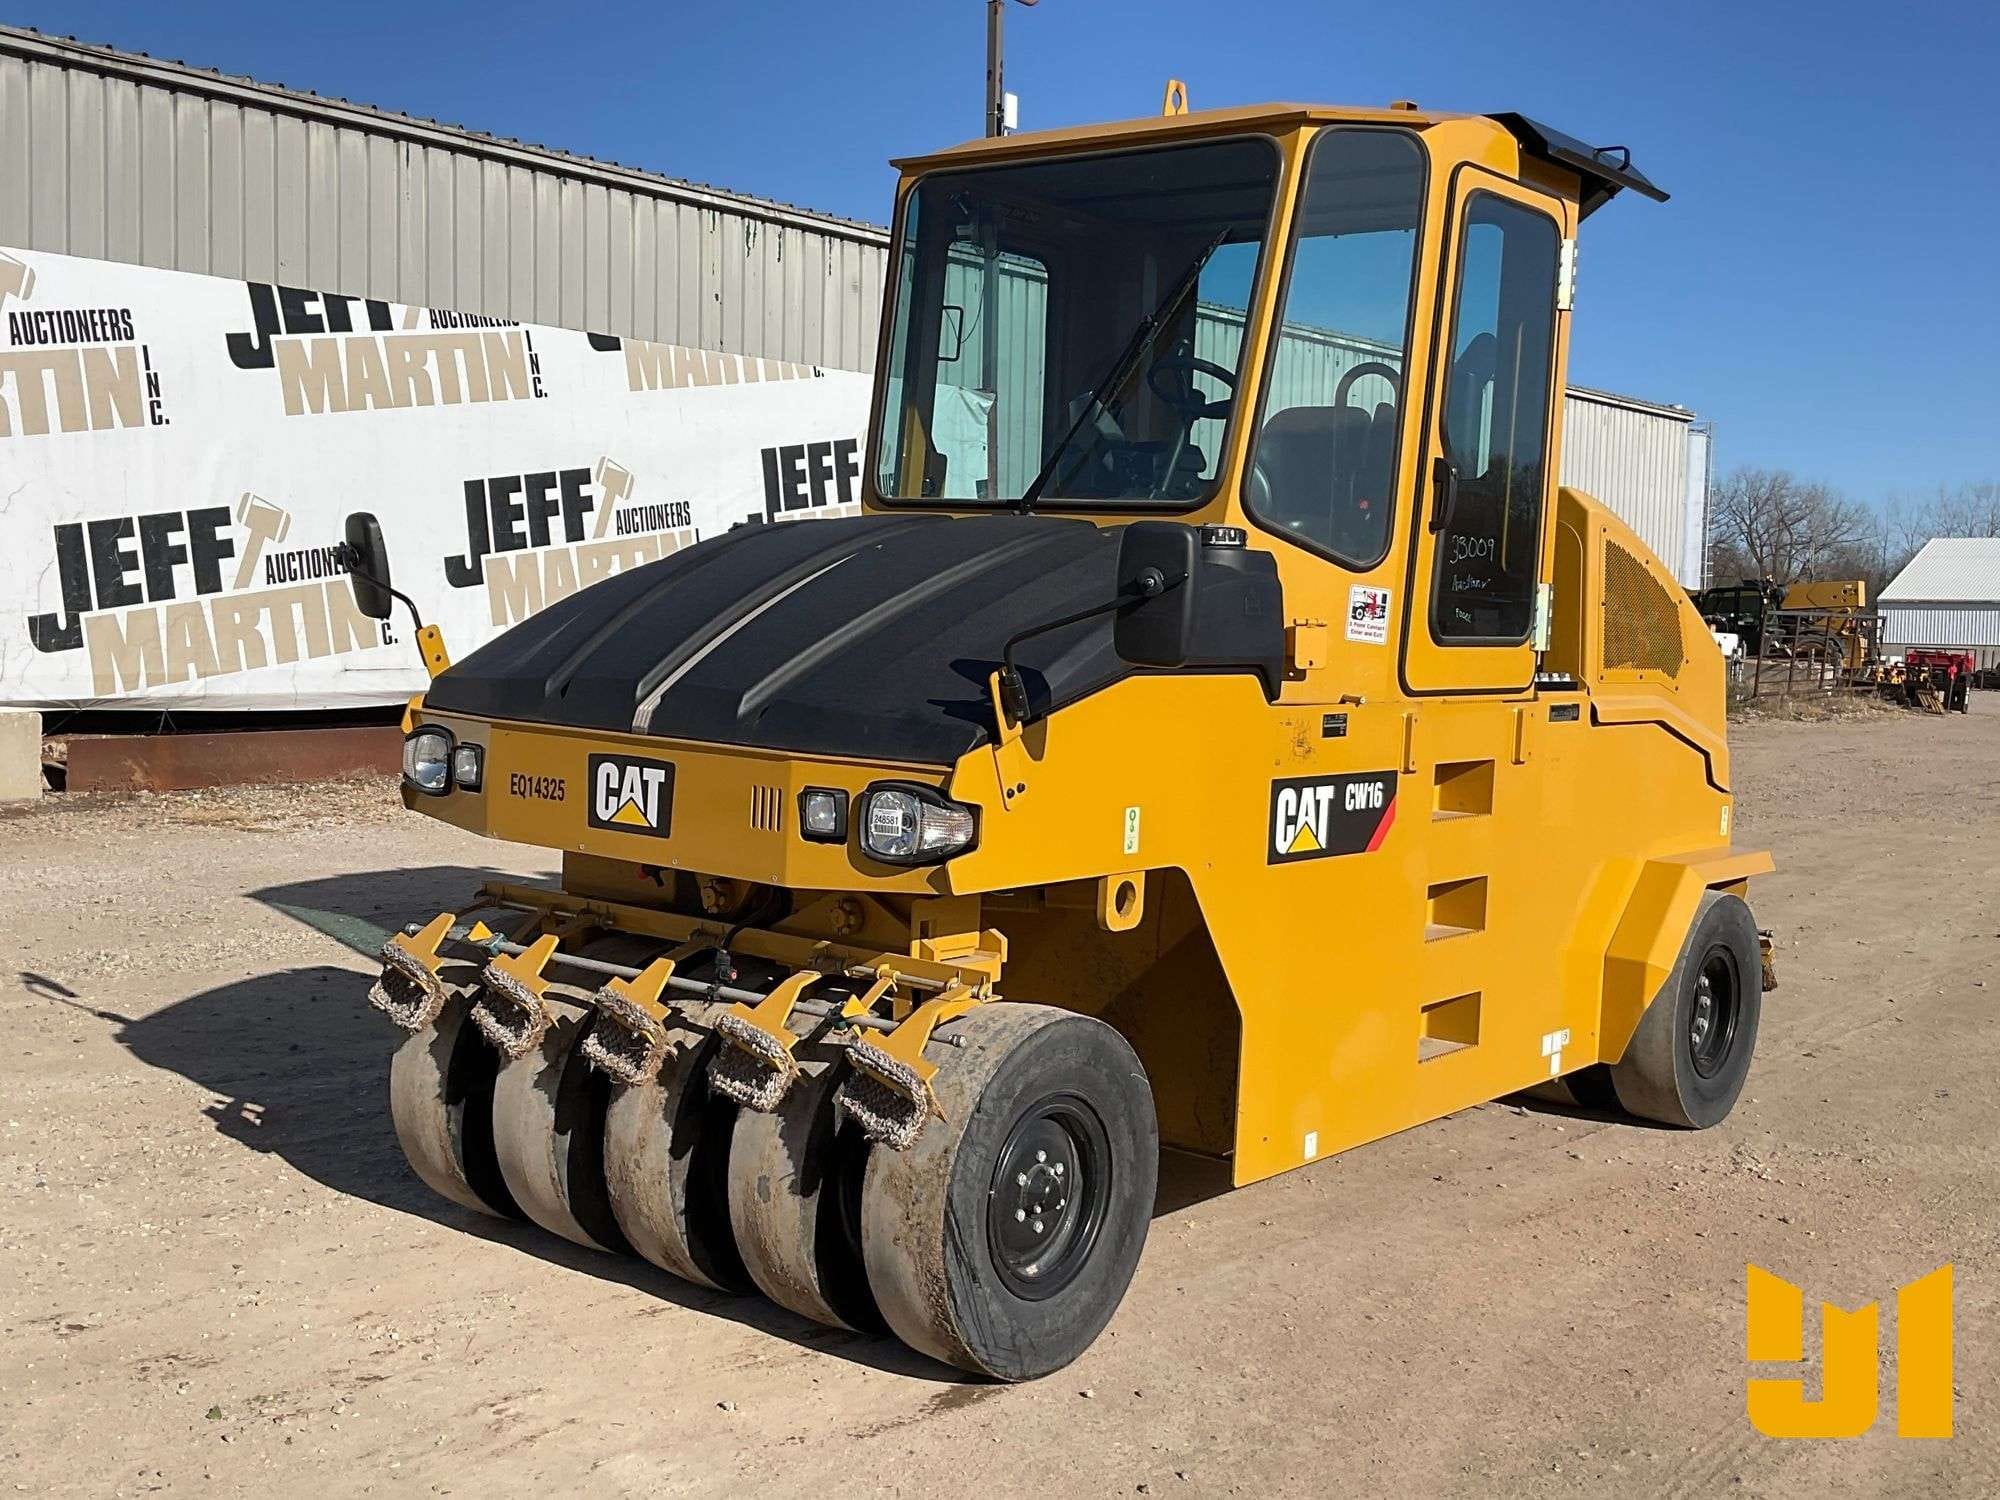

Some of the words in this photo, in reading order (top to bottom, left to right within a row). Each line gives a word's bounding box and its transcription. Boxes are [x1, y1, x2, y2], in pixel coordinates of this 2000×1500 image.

[8, 308, 135, 346] AUCTIONEERS
[142, 344, 170, 426] INC.
[275, 331, 531, 416] MARTIN
[525, 330, 548, 399] INC.
[444, 467, 594, 588] JEFF
[616, 501, 692, 536] AUCTIONEERS
[27, 505, 236, 653] JEFF
[85, 580, 379, 698] MARTIN
[510, 773, 566, 801] EQ14325
[595, 762, 666, 828] CAT
[1275, 785, 1335, 855] CAT
[1344, 781, 1384, 811] CW16
